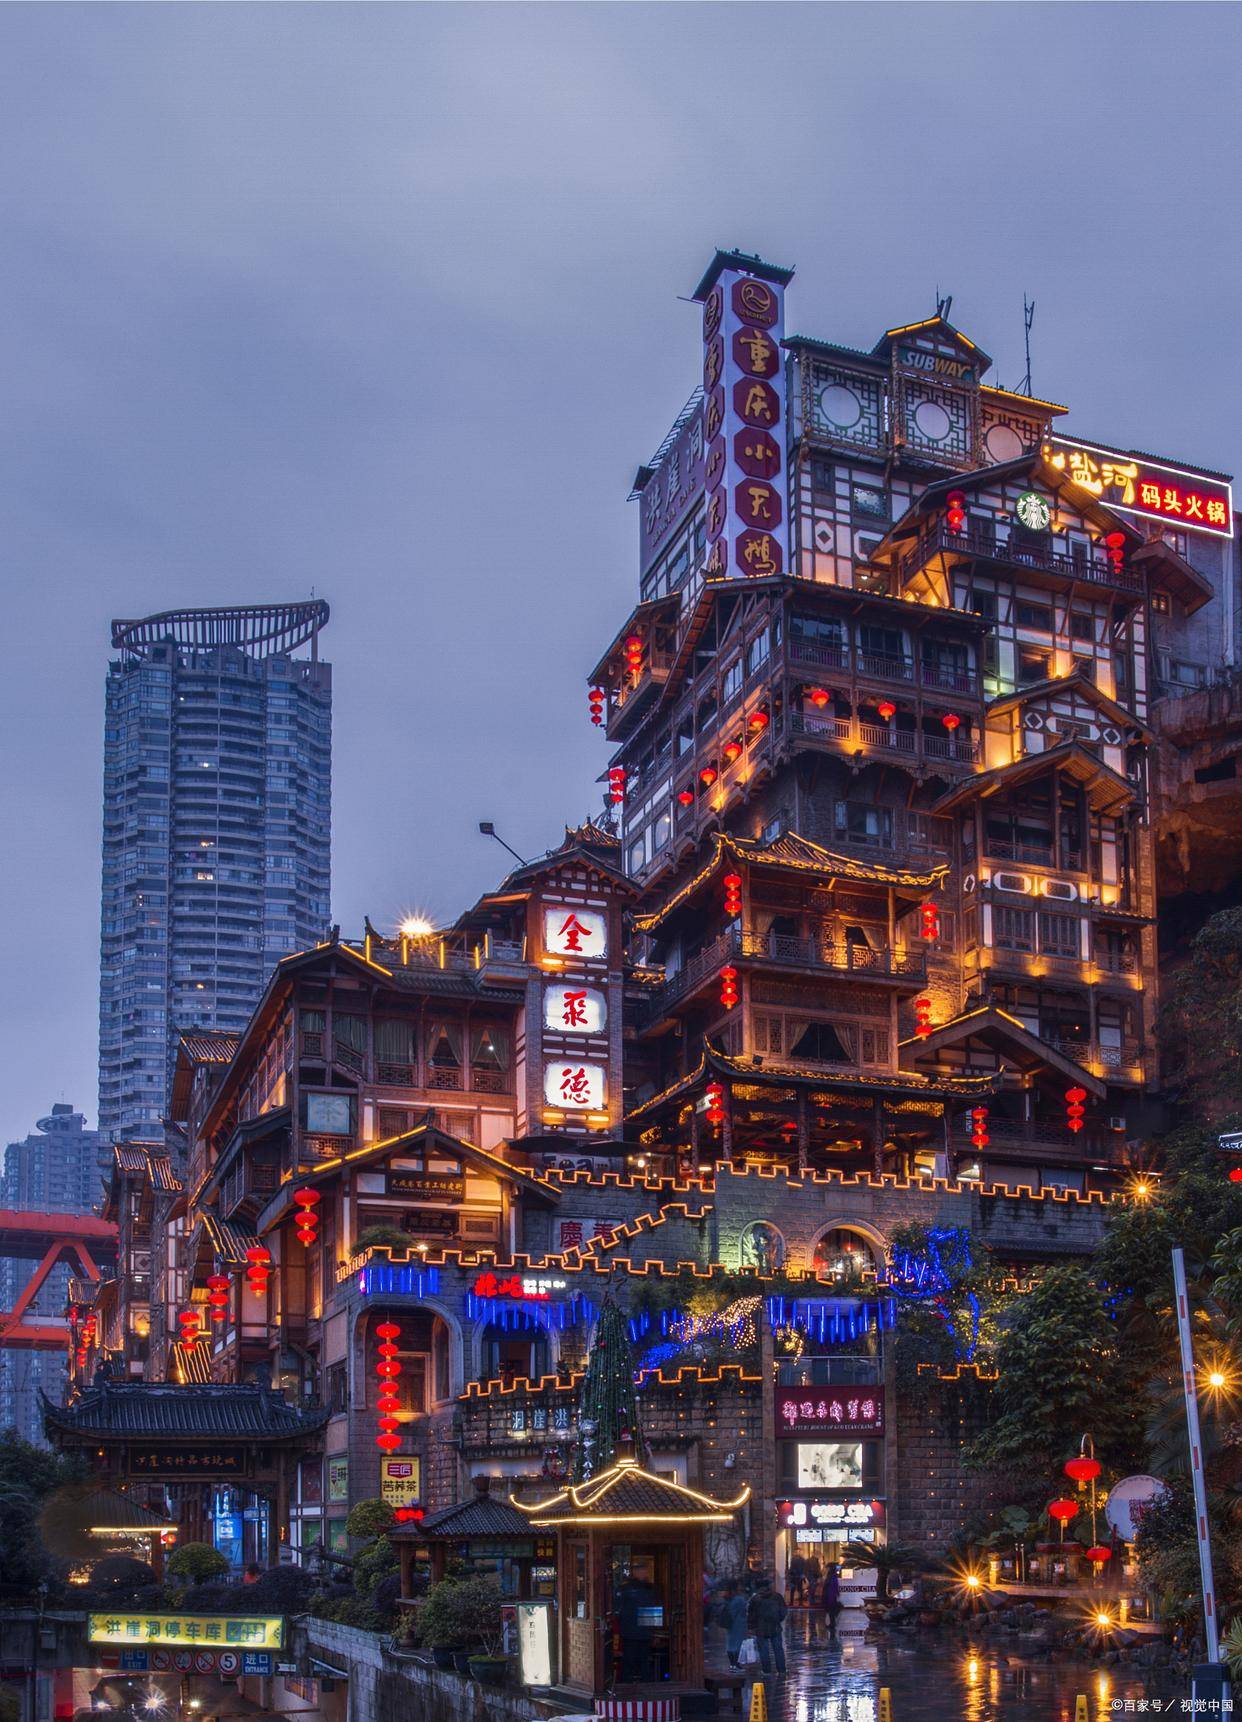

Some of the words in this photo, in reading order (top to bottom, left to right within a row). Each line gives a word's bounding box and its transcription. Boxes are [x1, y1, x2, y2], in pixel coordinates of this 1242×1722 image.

[902, 351, 971, 379] SUBWAY
[1141, 483, 1226, 525] 码头火锅
[557, 913, 593, 1104] 全聚德
[106, 1619, 222, 1640] 洪崖洞停车库
[224, 1655, 233, 1669] 5
[245, 1653, 268, 1665] 进口
